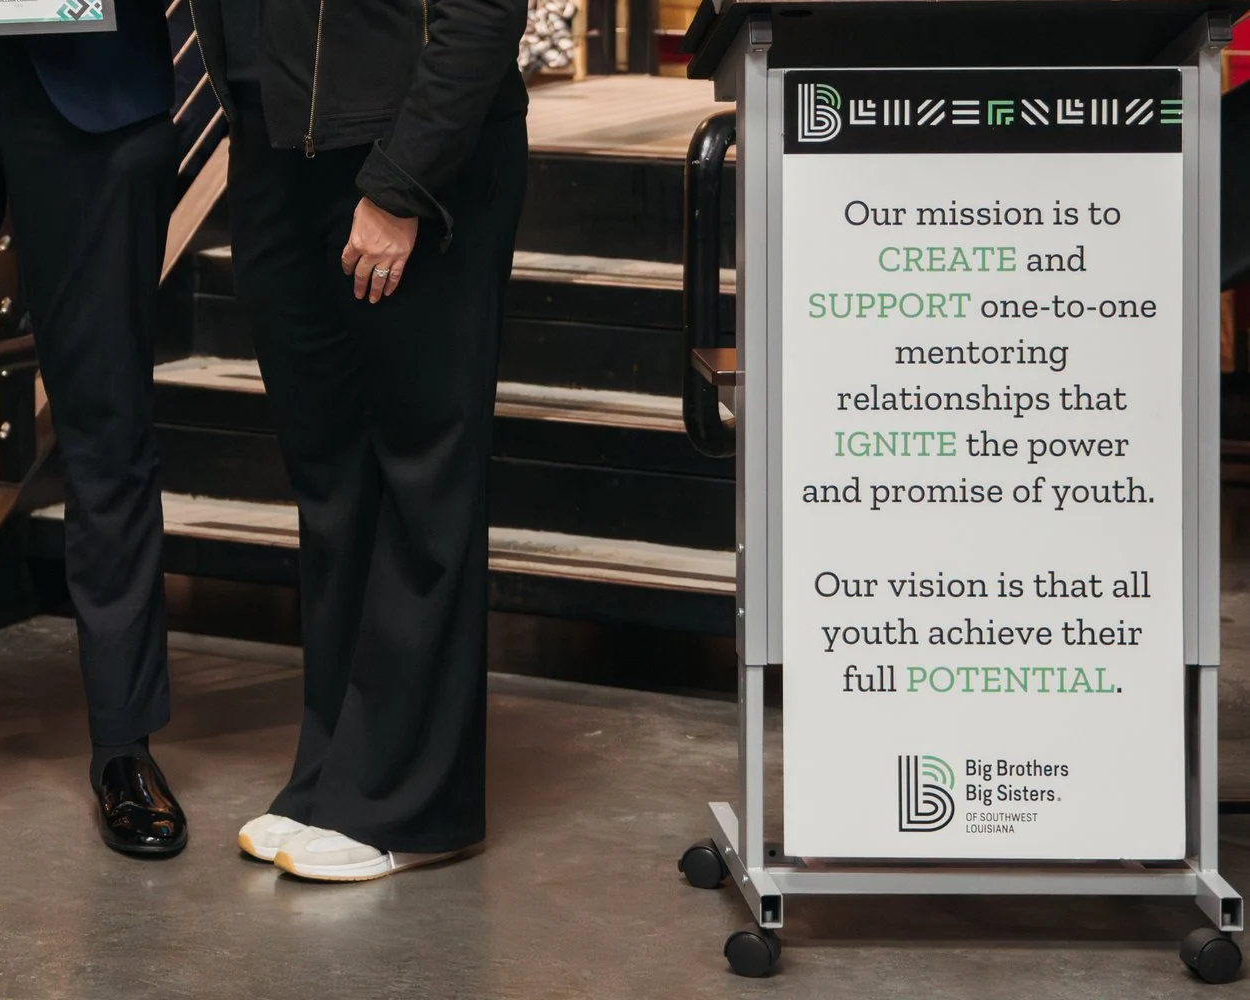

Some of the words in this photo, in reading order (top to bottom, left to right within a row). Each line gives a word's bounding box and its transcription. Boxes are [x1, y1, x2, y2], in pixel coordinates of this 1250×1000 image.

[844, 200, 907, 226] Our
[916, 200, 1044, 226] mission
[1052, 200, 1079, 226] is
[1088, 203, 1121, 226] to
[878, 246, 1017, 272] CREATE
[1026, 245, 1087, 272] and
[808, 293, 971, 318] SUPPORT
[980, 295, 1157, 318] one-to-one
[895, 339, 1069, 372] mentoring
[837, 384, 1050, 418] relationships
[1059, 384, 1128, 411] that
[834, 431, 957, 457] IGNITE
[966, 430, 1018, 456] the
[1027, 438, 1129, 464] power
[802, 476, 862, 503] and
[870, 478, 1003, 511] promise
[1012, 476, 1046, 503] of
[1052, 476, 1154, 511] youth.
[814, 571, 878, 598] Our
[888, 571, 988, 598] vision
[997, 571, 1024, 598] is
[1033, 571, 1103, 598] that
[1112, 571, 1151, 598] all
[822, 618, 919, 652] youth
[928, 618, 1053, 645] achieve
[1061, 618, 1143, 646] their
[842, 665, 897, 692] full
[906, 667, 1122, 693] POTENTIAL.
[965, 759, 993, 781] Big
[996, 759, 1069, 777] Brothers
[965, 784, 993, 806] Big
[965, 812, 978, 822] OF
[979, 812, 1038, 822] SOUTHWEST
[965, 824, 1015, 833] LOUISIANA
